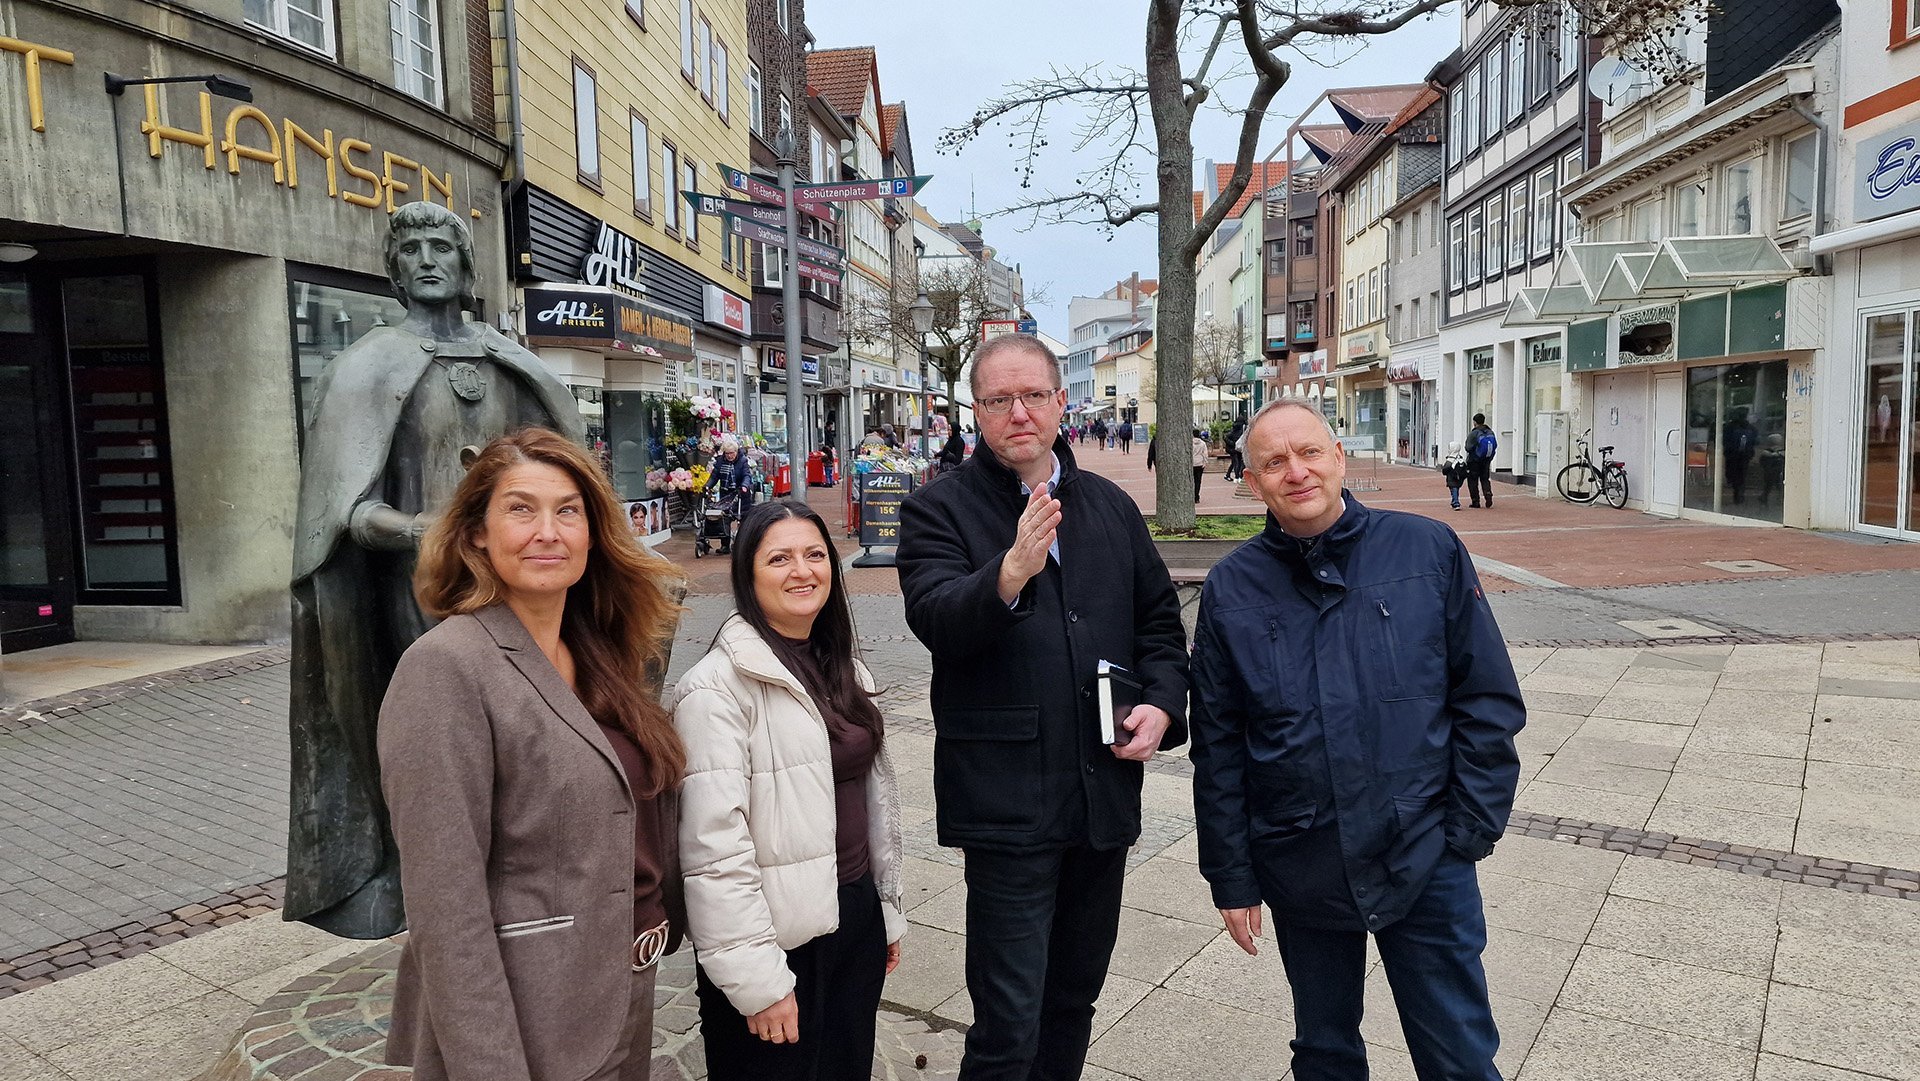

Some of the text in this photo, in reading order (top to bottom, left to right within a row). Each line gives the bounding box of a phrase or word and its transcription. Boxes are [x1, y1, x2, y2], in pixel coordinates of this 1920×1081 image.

[803, 187, 866, 199] Schützenplatz
[753, 207, 782, 221] Bahnhof
[757, 228, 785, 244] Stadtwache
[586, 220, 646, 293] Ali
[537, 301, 604, 325] Ali
[562, 318, 605, 328] FRISEUR
[879, 529, 896, 537] 25€
